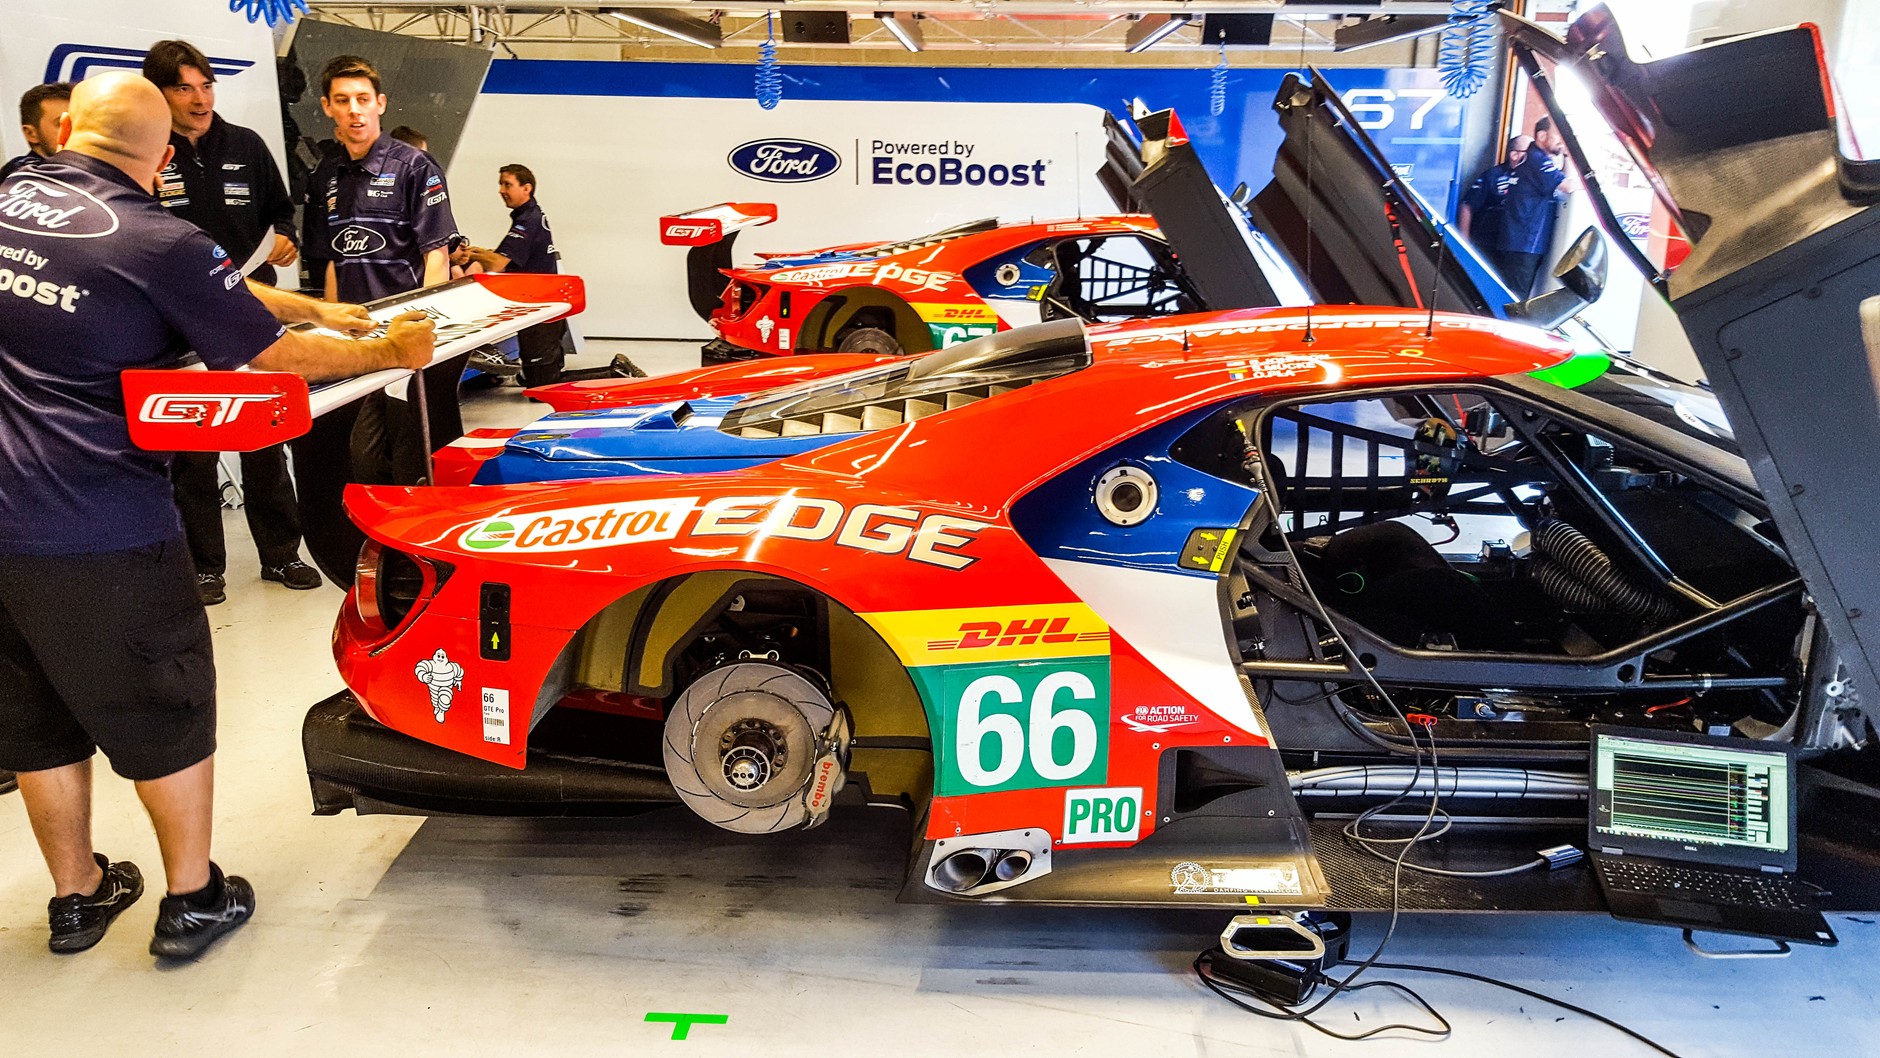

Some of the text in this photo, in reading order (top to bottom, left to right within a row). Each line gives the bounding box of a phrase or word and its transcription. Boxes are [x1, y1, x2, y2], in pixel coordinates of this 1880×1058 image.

[1341, 88, 1448, 130] 67
[750, 144, 819, 175] Ford
[871, 140, 974, 158] Powered by
[872, 157, 1046, 186] EcoBoost
[0, 180, 86, 229] Ford
[666, 224, 716, 238] GT
[1622, 216, 1650, 235] For
[342, 230, 369, 252] Ford
[23, 250, 49, 270] by
[789, 267, 844, 283] Castrol
[944, 309, 986, 318] DHL
[138, 393, 283, 427] GT
[515, 495, 994, 572] Castrol EDGE
[1215, 541, 1229, 561] PUSH
[957, 617, 1078, 649] DHL
[483, 693, 494, 703] 66
[483, 705, 494, 713] GTE
[495, 706, 504, 714] Pro
[1147, 714, 1168, 722] ROAD
[1169, 714, 1199, 722] SAFETY
[1149, 705, 1185, 715] ACTION
[956, 671, 1098, 787] 66
[811, 760, 834, 808] brembo
[1068, 796, 1137, 835] PRO
